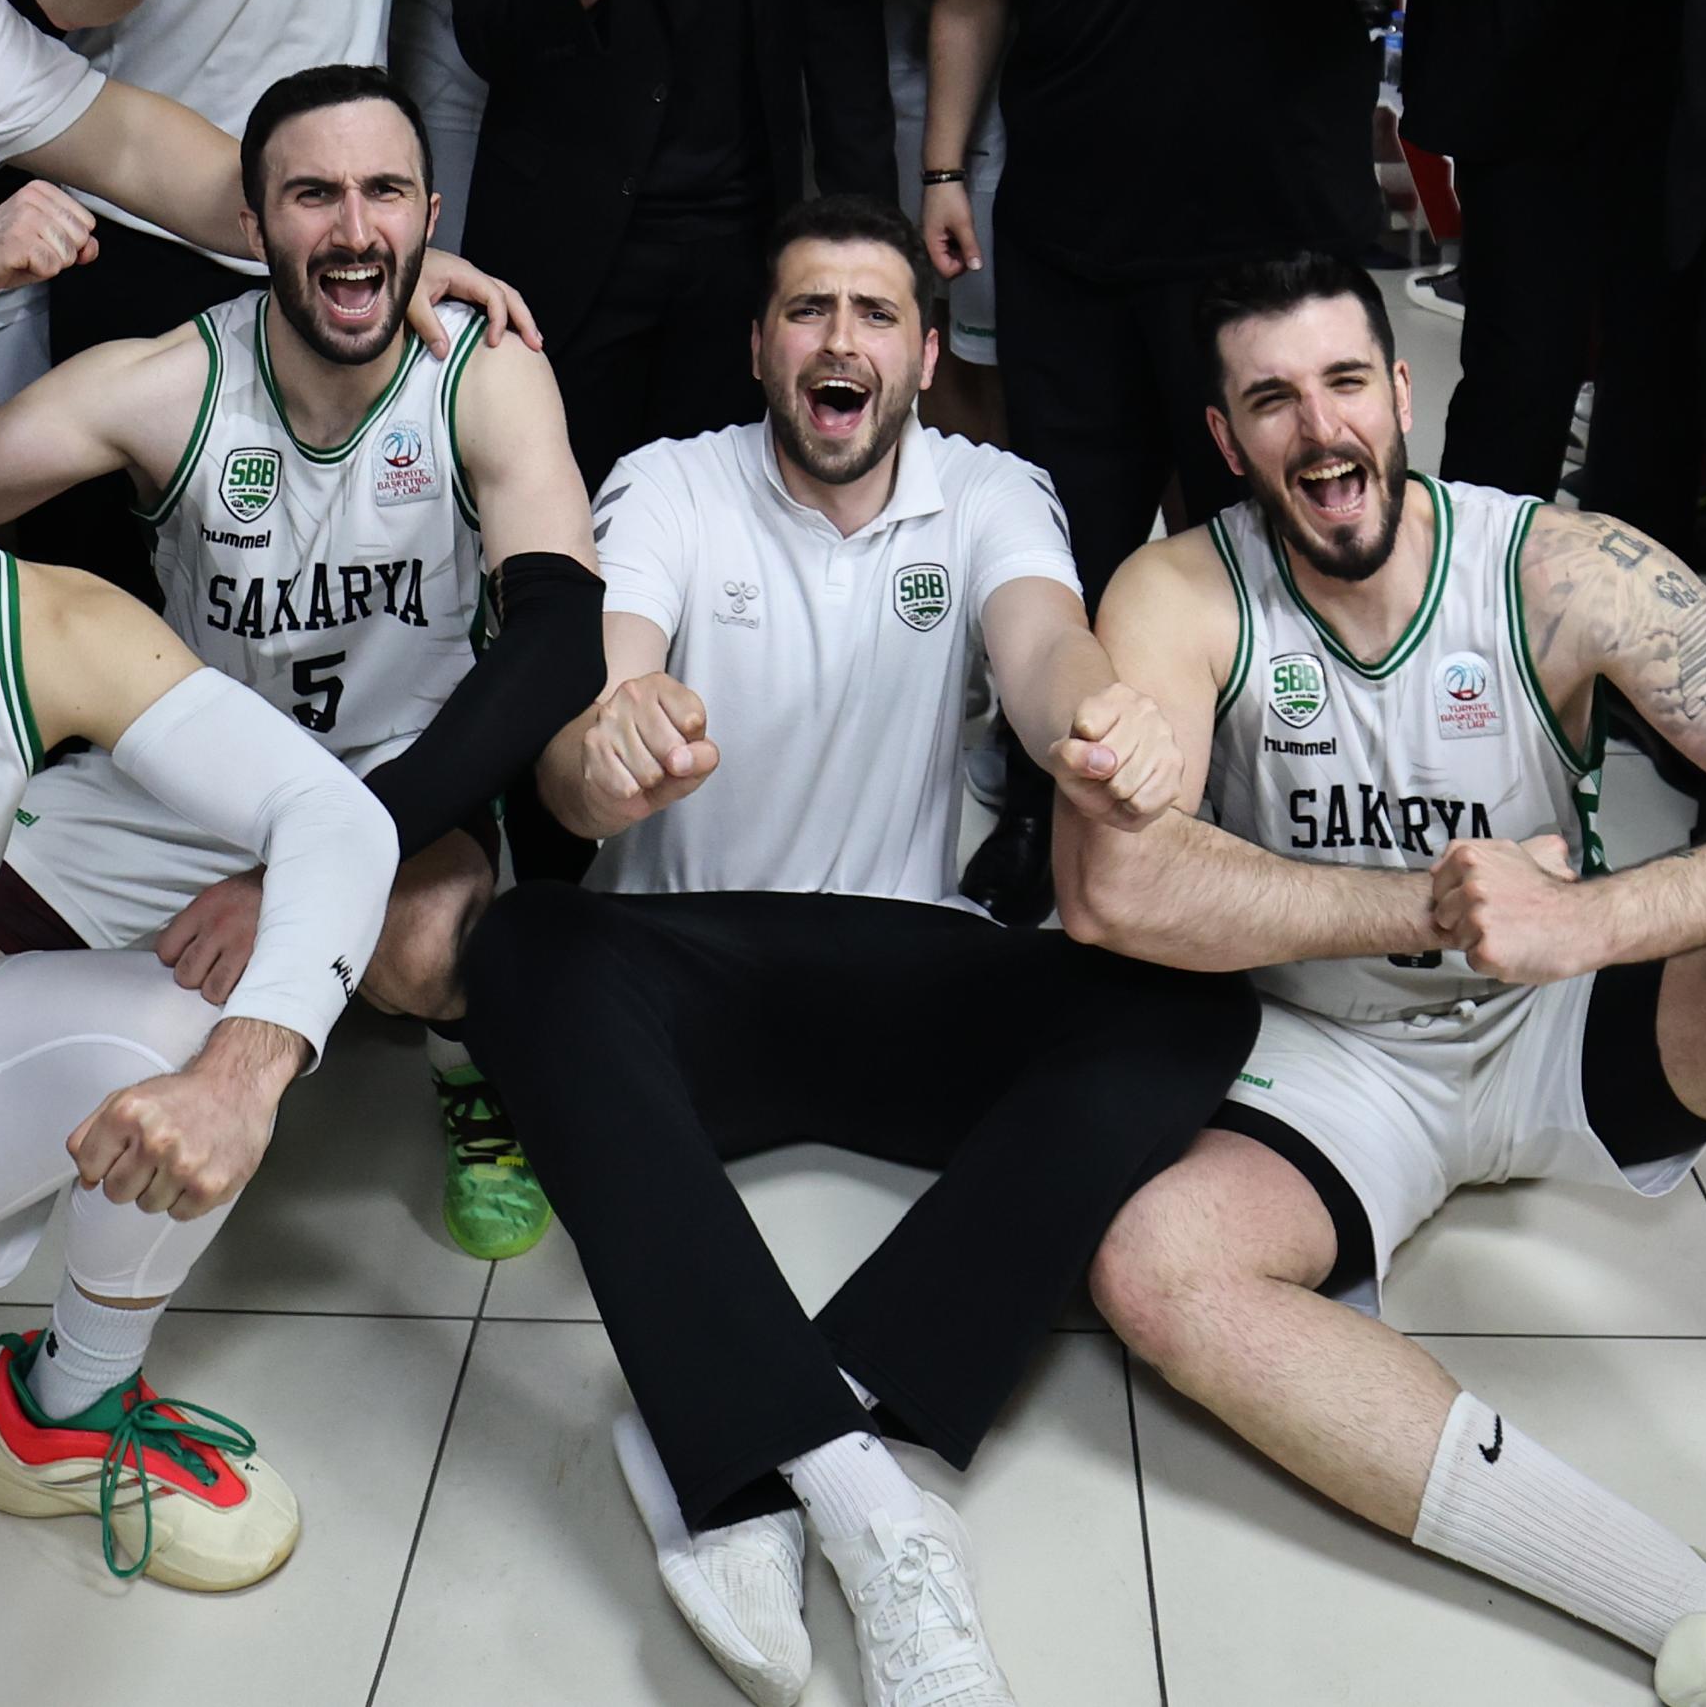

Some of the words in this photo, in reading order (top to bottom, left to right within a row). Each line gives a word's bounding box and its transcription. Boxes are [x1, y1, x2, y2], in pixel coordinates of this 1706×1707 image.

[228, 458, 276, 487] SBB
[200, 523, 272, 549] hummel
[207, 558, 429, 640] SAKARYA
[900, 573, 945, 603] SBB
[712, 610, 761, 630] hummel
[292, 651, 346, 734] 5
[1274, 664, 1320, 694] SBB
[1263, 735, 1338, 757] hummel
